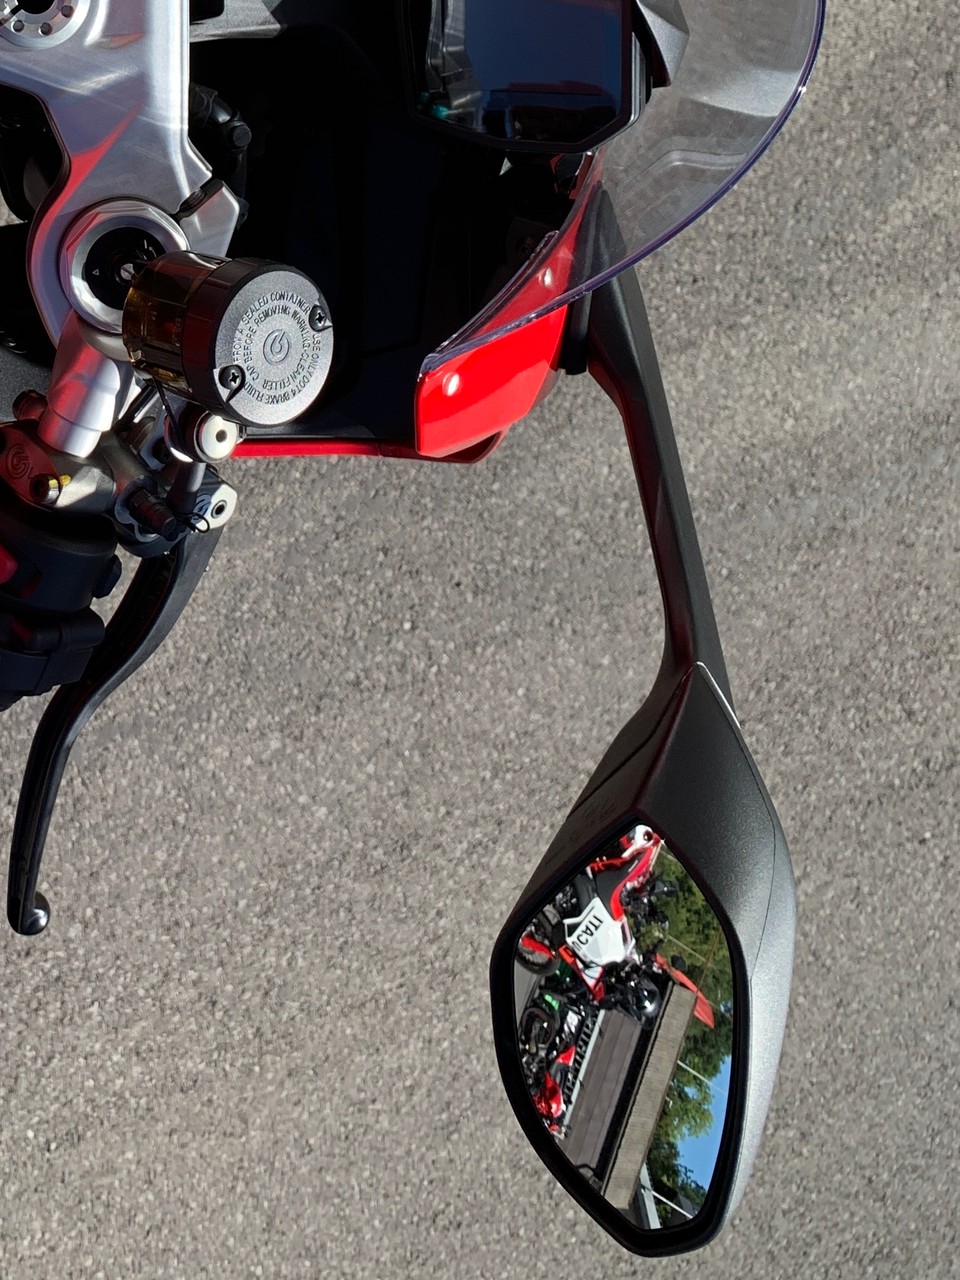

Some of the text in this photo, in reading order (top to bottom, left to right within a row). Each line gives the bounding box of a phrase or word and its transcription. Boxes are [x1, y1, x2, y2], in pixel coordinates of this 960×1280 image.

[241, 296, 268, 324] SEALED
[270, 291, 311, 315] CONTAINER
[253, 304, 291, 326] REMOVING
[243, 326, 256, 363] BEFORE
[312, 333, 320, 351] USE
[246, 364, 260, 381] CAP
[306, 353, 319, 375] ONLY
[262, 376, 291, 391] FILLER
[265, 391, 290, 405] BRAKE
